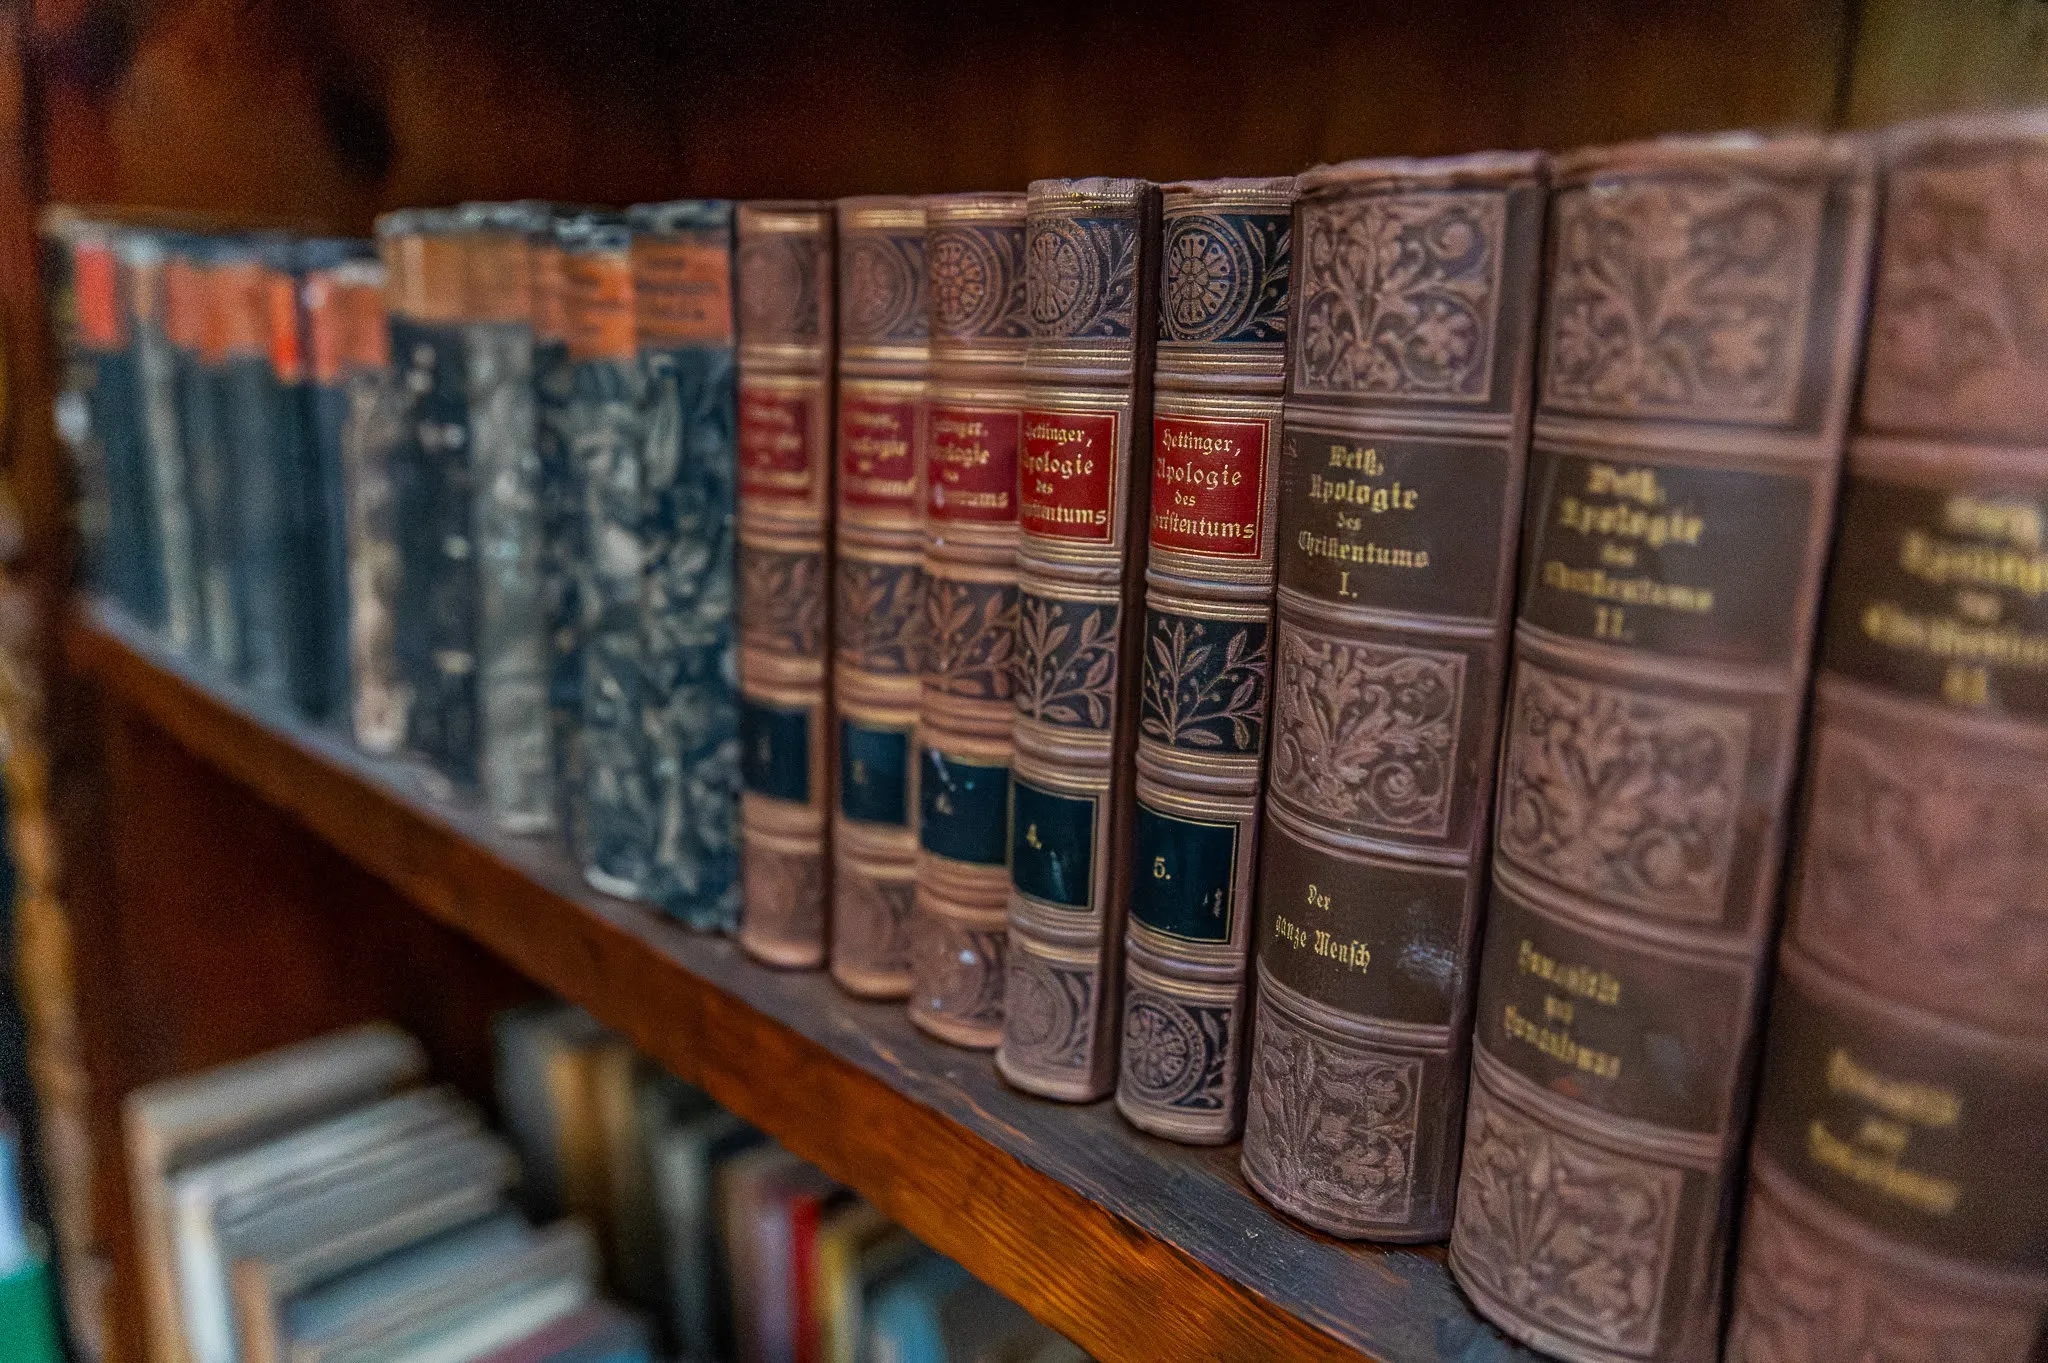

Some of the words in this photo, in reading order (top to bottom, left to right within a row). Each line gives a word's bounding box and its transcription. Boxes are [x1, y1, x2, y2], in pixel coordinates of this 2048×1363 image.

[1163, 428, 1241, 457] Hettinger,
[1157, 457, 1242, 490] Apologie
[1174, 489, 1196, 507] des
[1308, 473, 1419, 514] Apologie
[1338, 571, 1359, 599] I.
[1153, 856, 1172, 880] 5.
[1307, 884, 1331, 911] Der
[1274, 914, 1307, 949] ganze
[1314, 929, 1371, 974] Mensch
